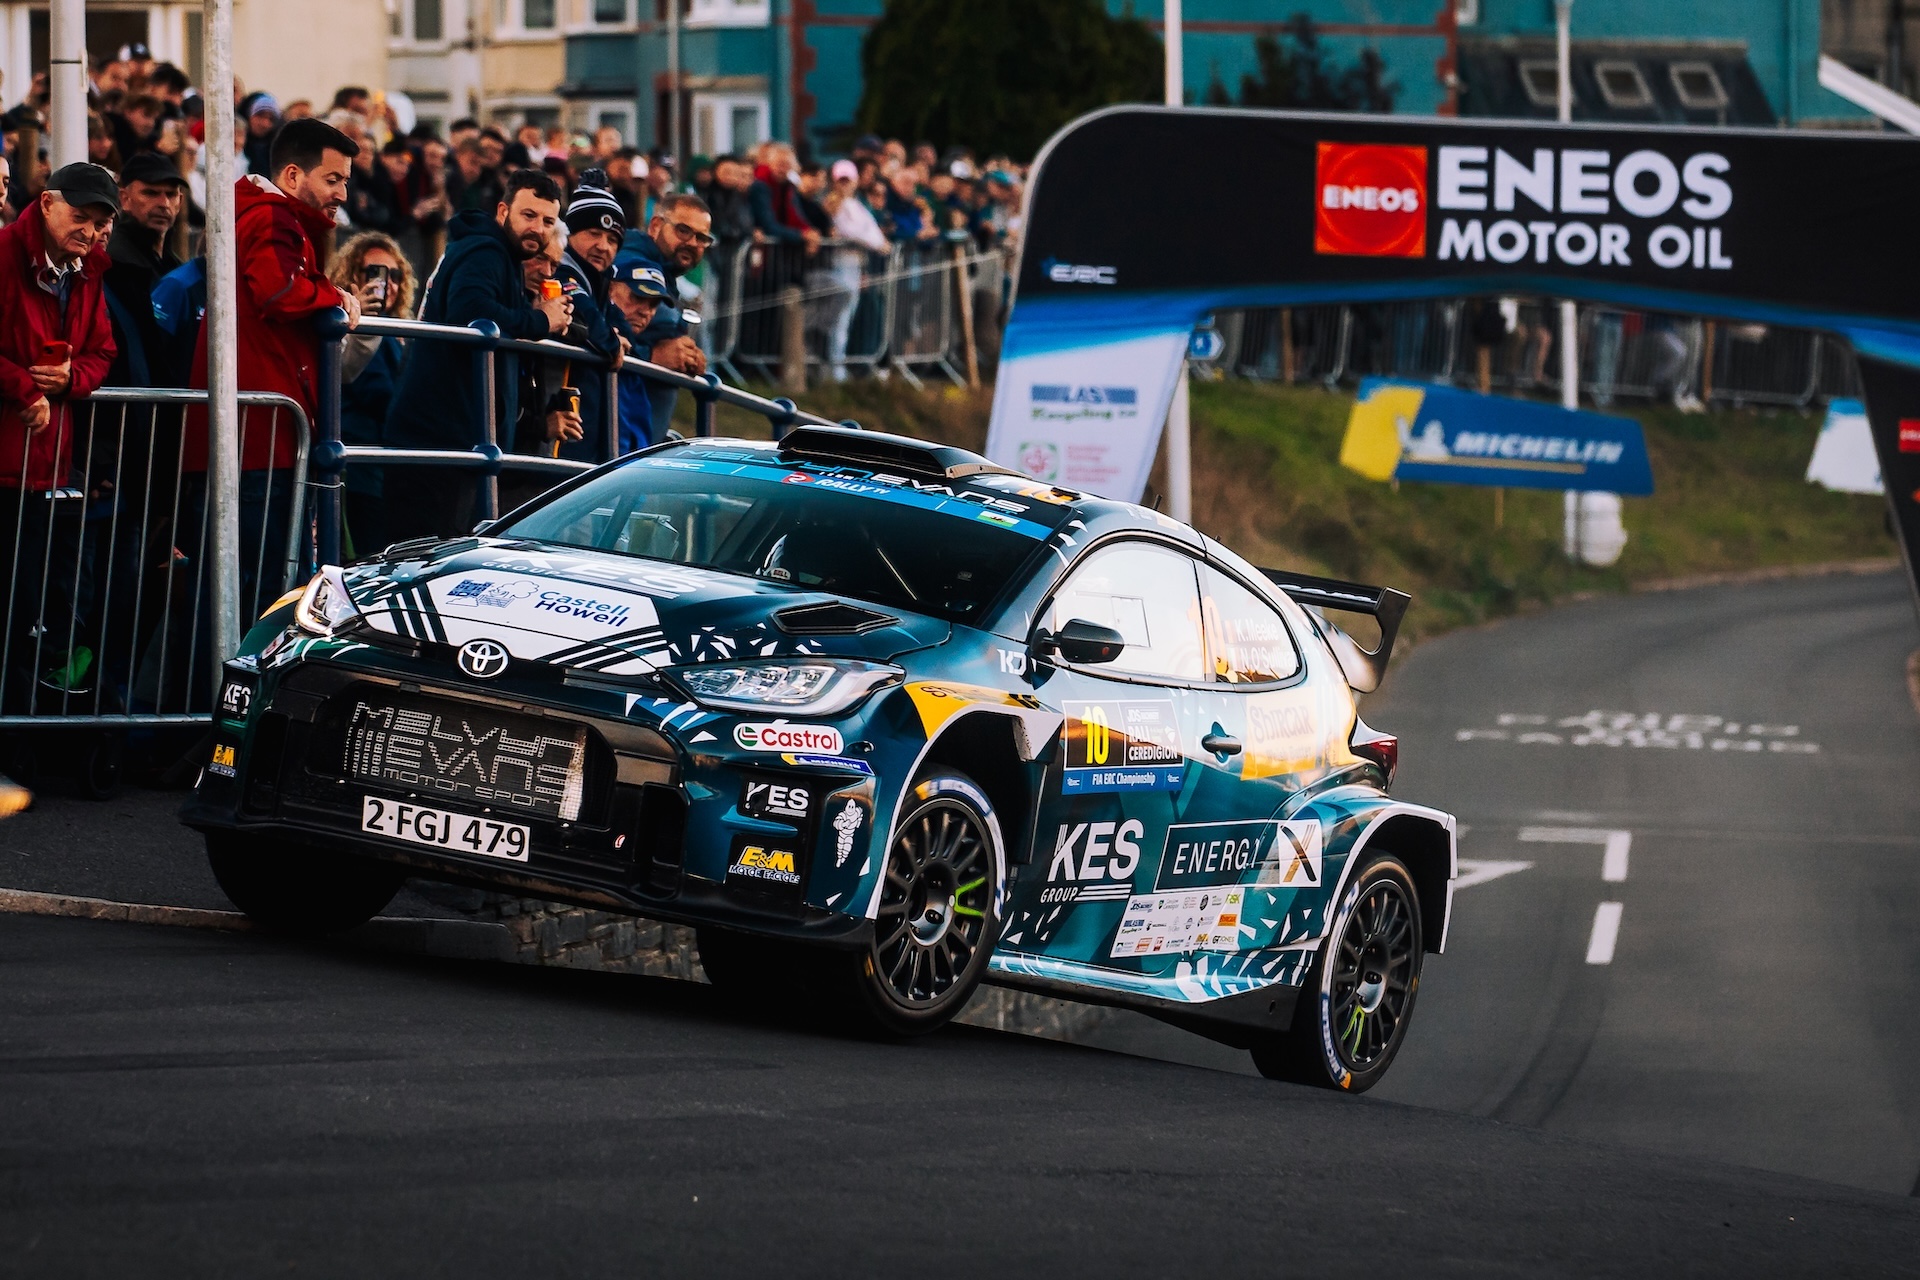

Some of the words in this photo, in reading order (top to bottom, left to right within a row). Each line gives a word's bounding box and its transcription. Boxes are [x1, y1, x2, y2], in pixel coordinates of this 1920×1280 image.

[1437, 145, 1733, 220] ENEOS
[1322, 185, 1419, 213] ENEOS
[1437, 217, 1632, 266] MOTOR
[1647, 224, 1733, 269] OIL
[1050, 263, 1118, 285] ERC
[1453, 430, 1624, 464] MICHELIN
[814, 478, 871, 493] RALLY
[481, 560, 567, 577] GROUP
[534, 599, 630, 628] Howell
[540, 591, 632, 617] Castell
[761, 728, 838, 751] Castrol
[1081, 705, 1109, 765] 10
[1128, 726, 1151, 743] RALI
[810, 759, 862, 770] MICHELIN
[1128, 745, 1178, 761] CEREDIGION
[1092, 773, 1104, 786] FIA
[1104, 773, 1117, 785] ERC
[1116, 772, 1156, 787] Championship
[739, 846, 796, 873] E&M
[1047, 818, 1145, 883] KES
[728, 865, 762, 879] MOTOR
[763, 869, 801, 885] FACTORS
[1040, 886, 1079, 905] GROUP
